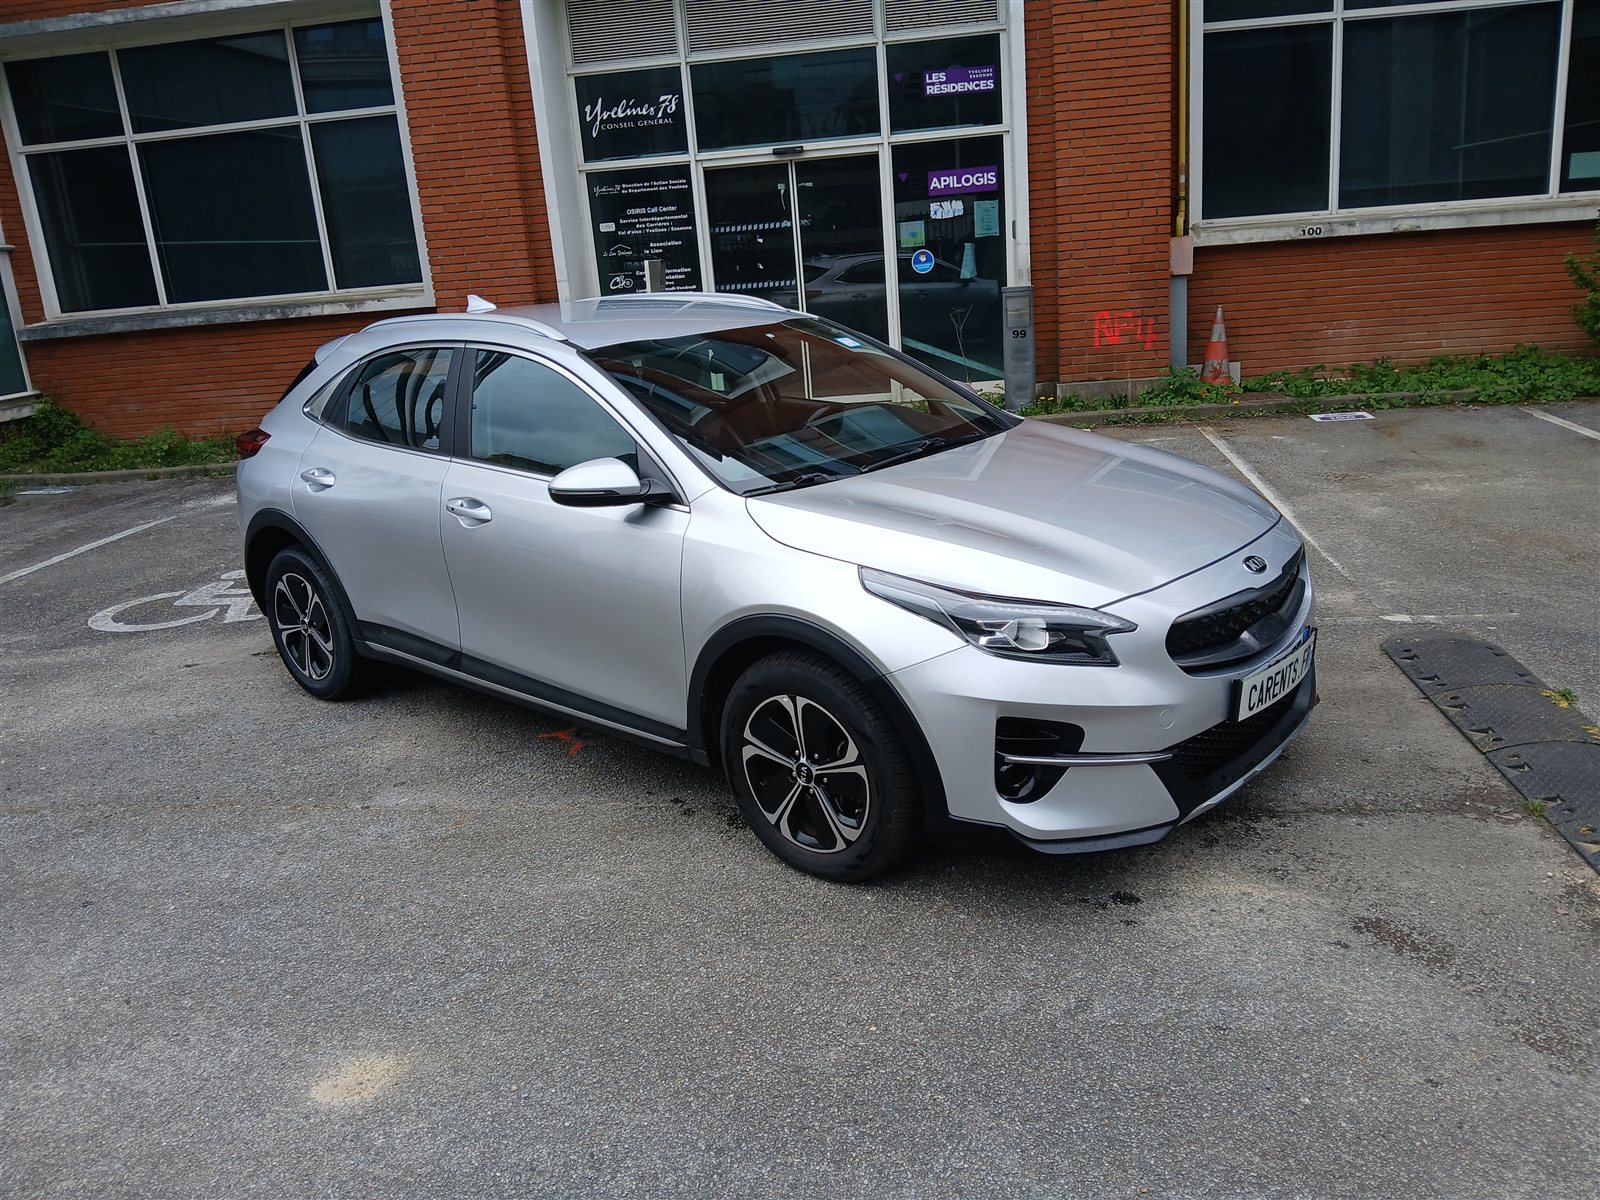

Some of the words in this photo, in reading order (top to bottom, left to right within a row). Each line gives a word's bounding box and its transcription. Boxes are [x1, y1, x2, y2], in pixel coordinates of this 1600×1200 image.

[926, 72, 947, 83] LES
[926, 80, 995, 95] RÉSIDENCES
[657, 94, 680, 118] 78
[601, 121, 635, 130] CONSEIL
[637, 117, 674, 127] GENERAL
[929, 172, 997, 190] APILOGIS
[1300, 226, 1322, 236] 100
[649, 240, 682, 248] Association
[1012, 330, 1027, 339] 99
